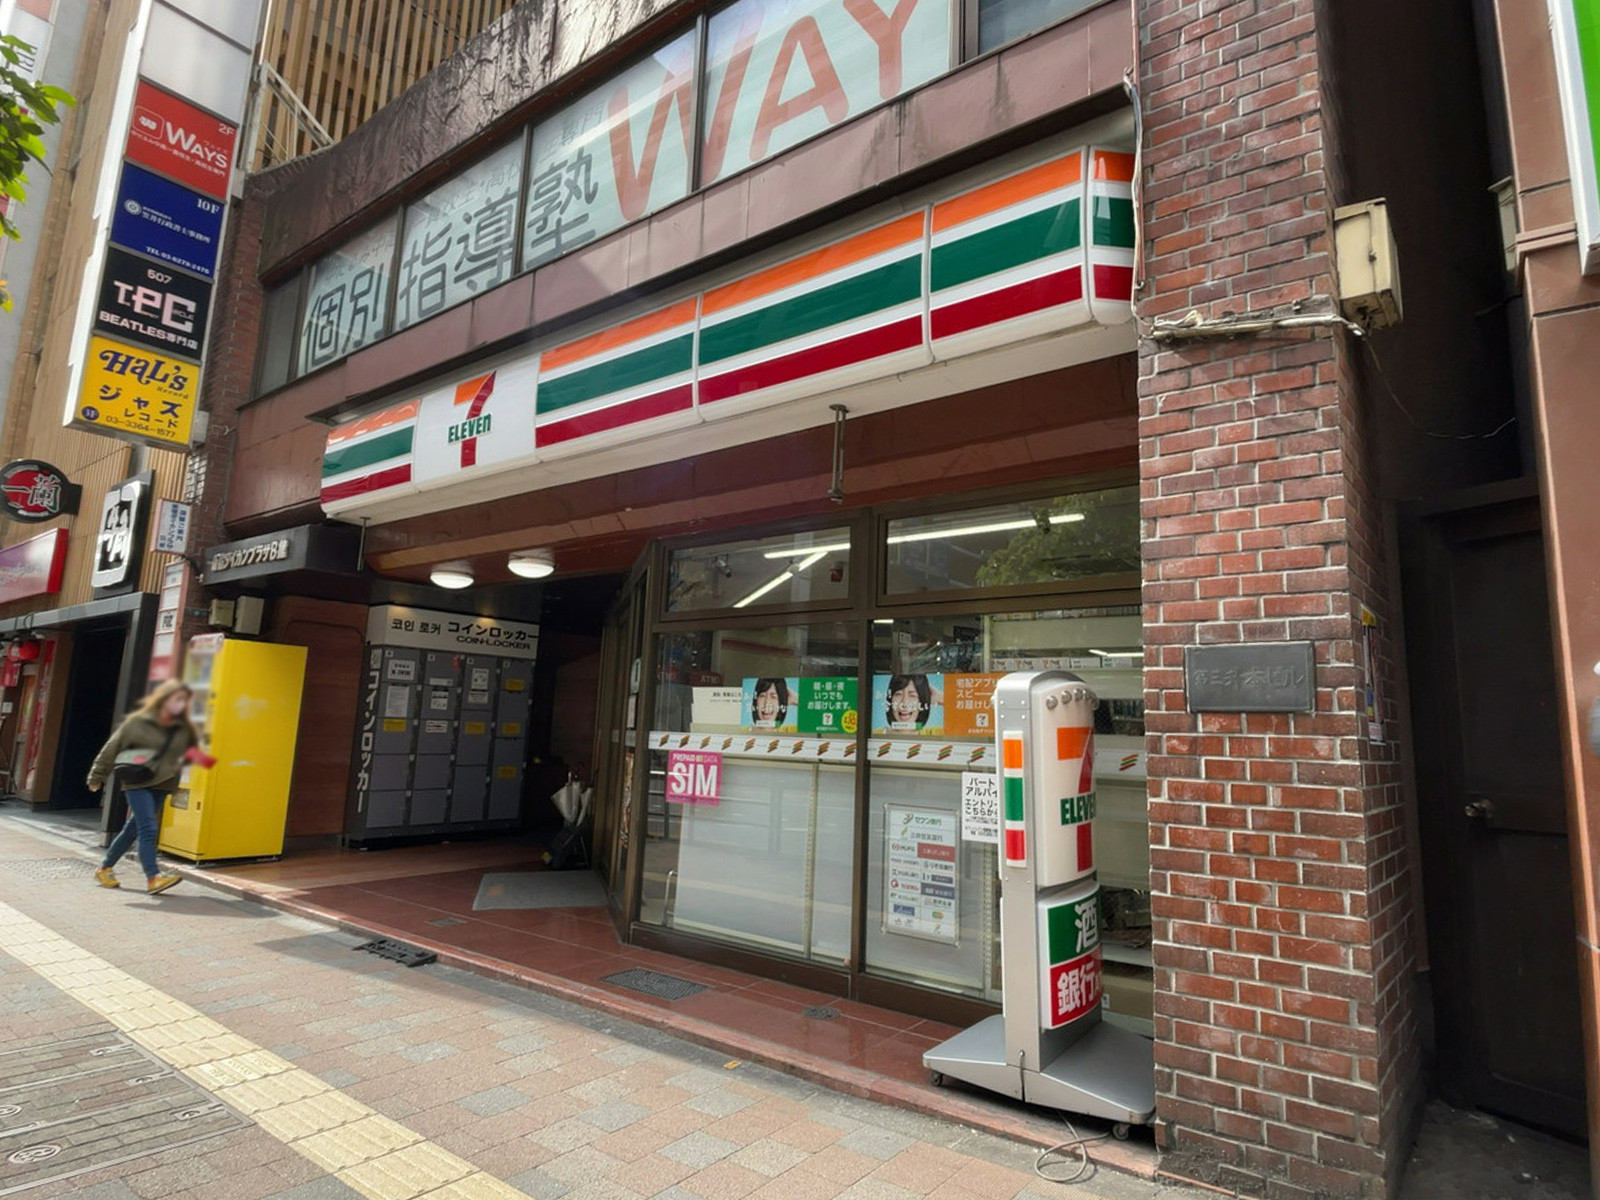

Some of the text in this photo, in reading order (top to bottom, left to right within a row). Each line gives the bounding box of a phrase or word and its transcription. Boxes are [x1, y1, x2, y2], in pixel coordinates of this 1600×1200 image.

[219, 123, 235, 135] 2F
[197, 199, 220, 214] 10F
[296, 147, 600, 373] 個別指導塾
[124, 408, 178, 428] レコード
[0, 474, 62, 513] 一蘭
[391, 618, 540, 641] 코인 로커 コインロッカー
[671, 762, 718, 797] SIM
[970, 777, 995, 787] パート
[965, 798, 998, 808] エントリ
[1074, 897, 1098, 954] 酒
